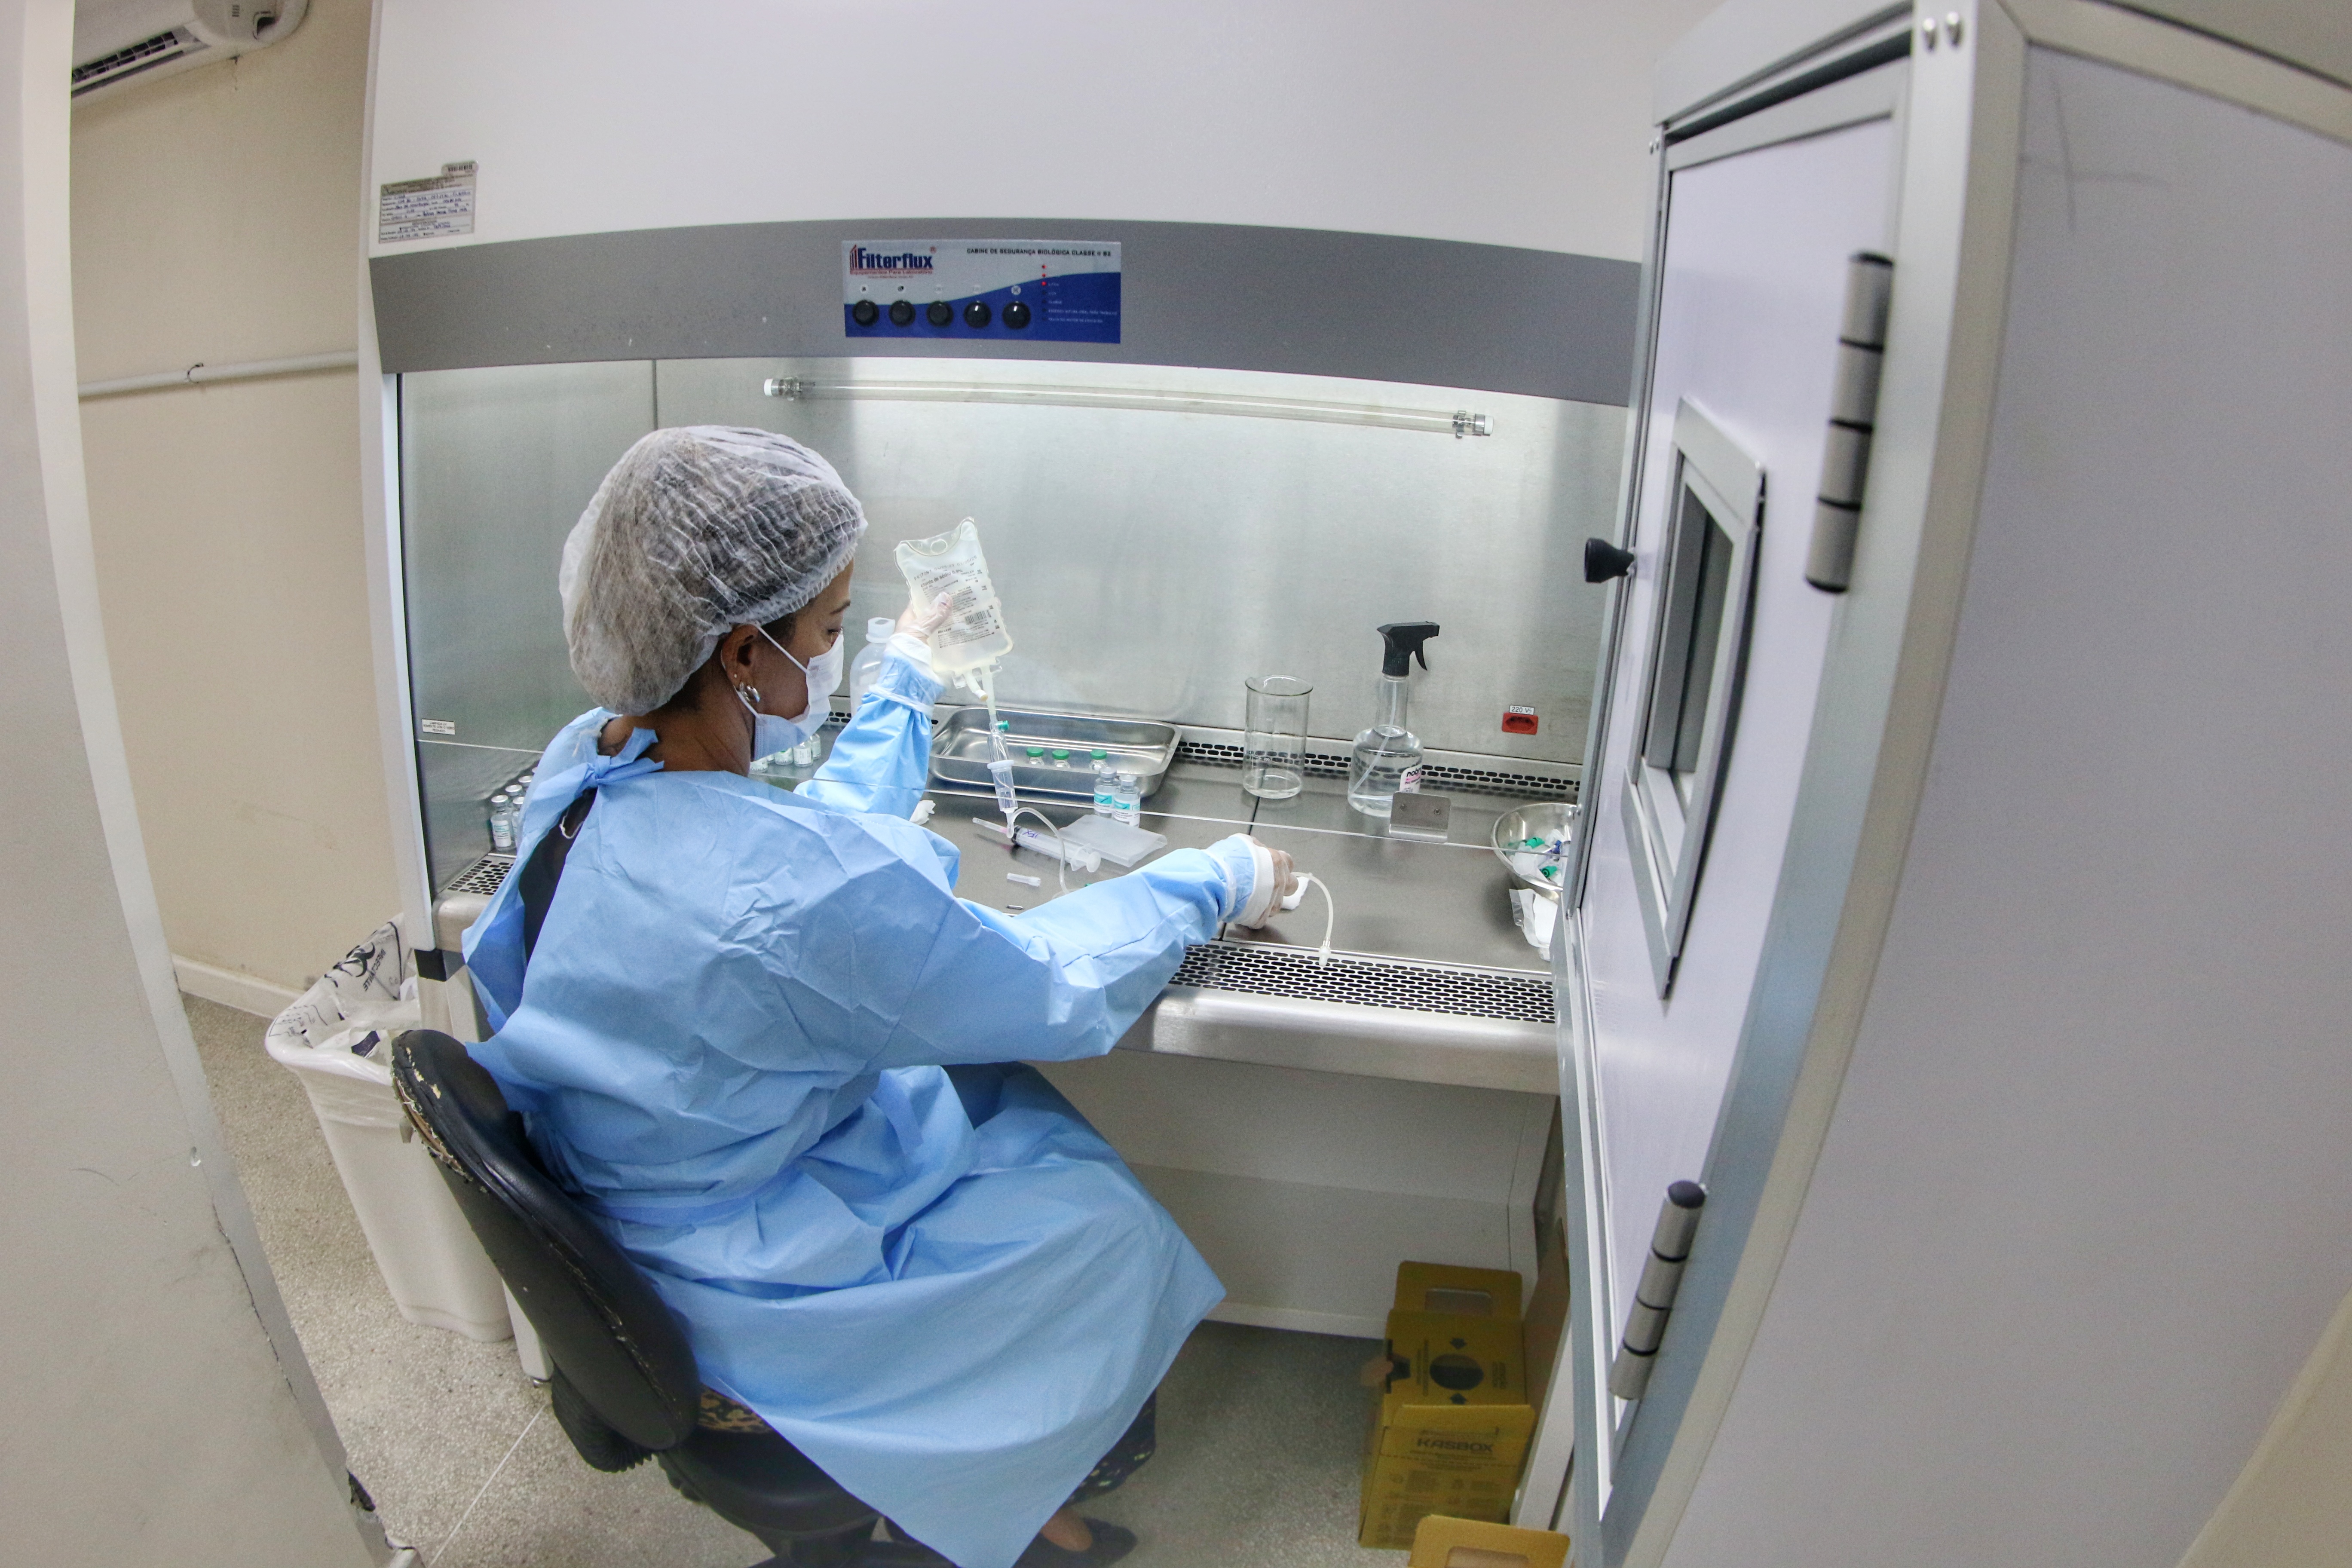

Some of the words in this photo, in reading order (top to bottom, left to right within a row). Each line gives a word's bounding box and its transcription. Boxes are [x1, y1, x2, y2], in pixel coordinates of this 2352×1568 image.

[858, 248, 933, 269] Filterflux
[920, 580, 934, 588] cloreto
[1417, 1438, 1493, 1452] KASBOX
